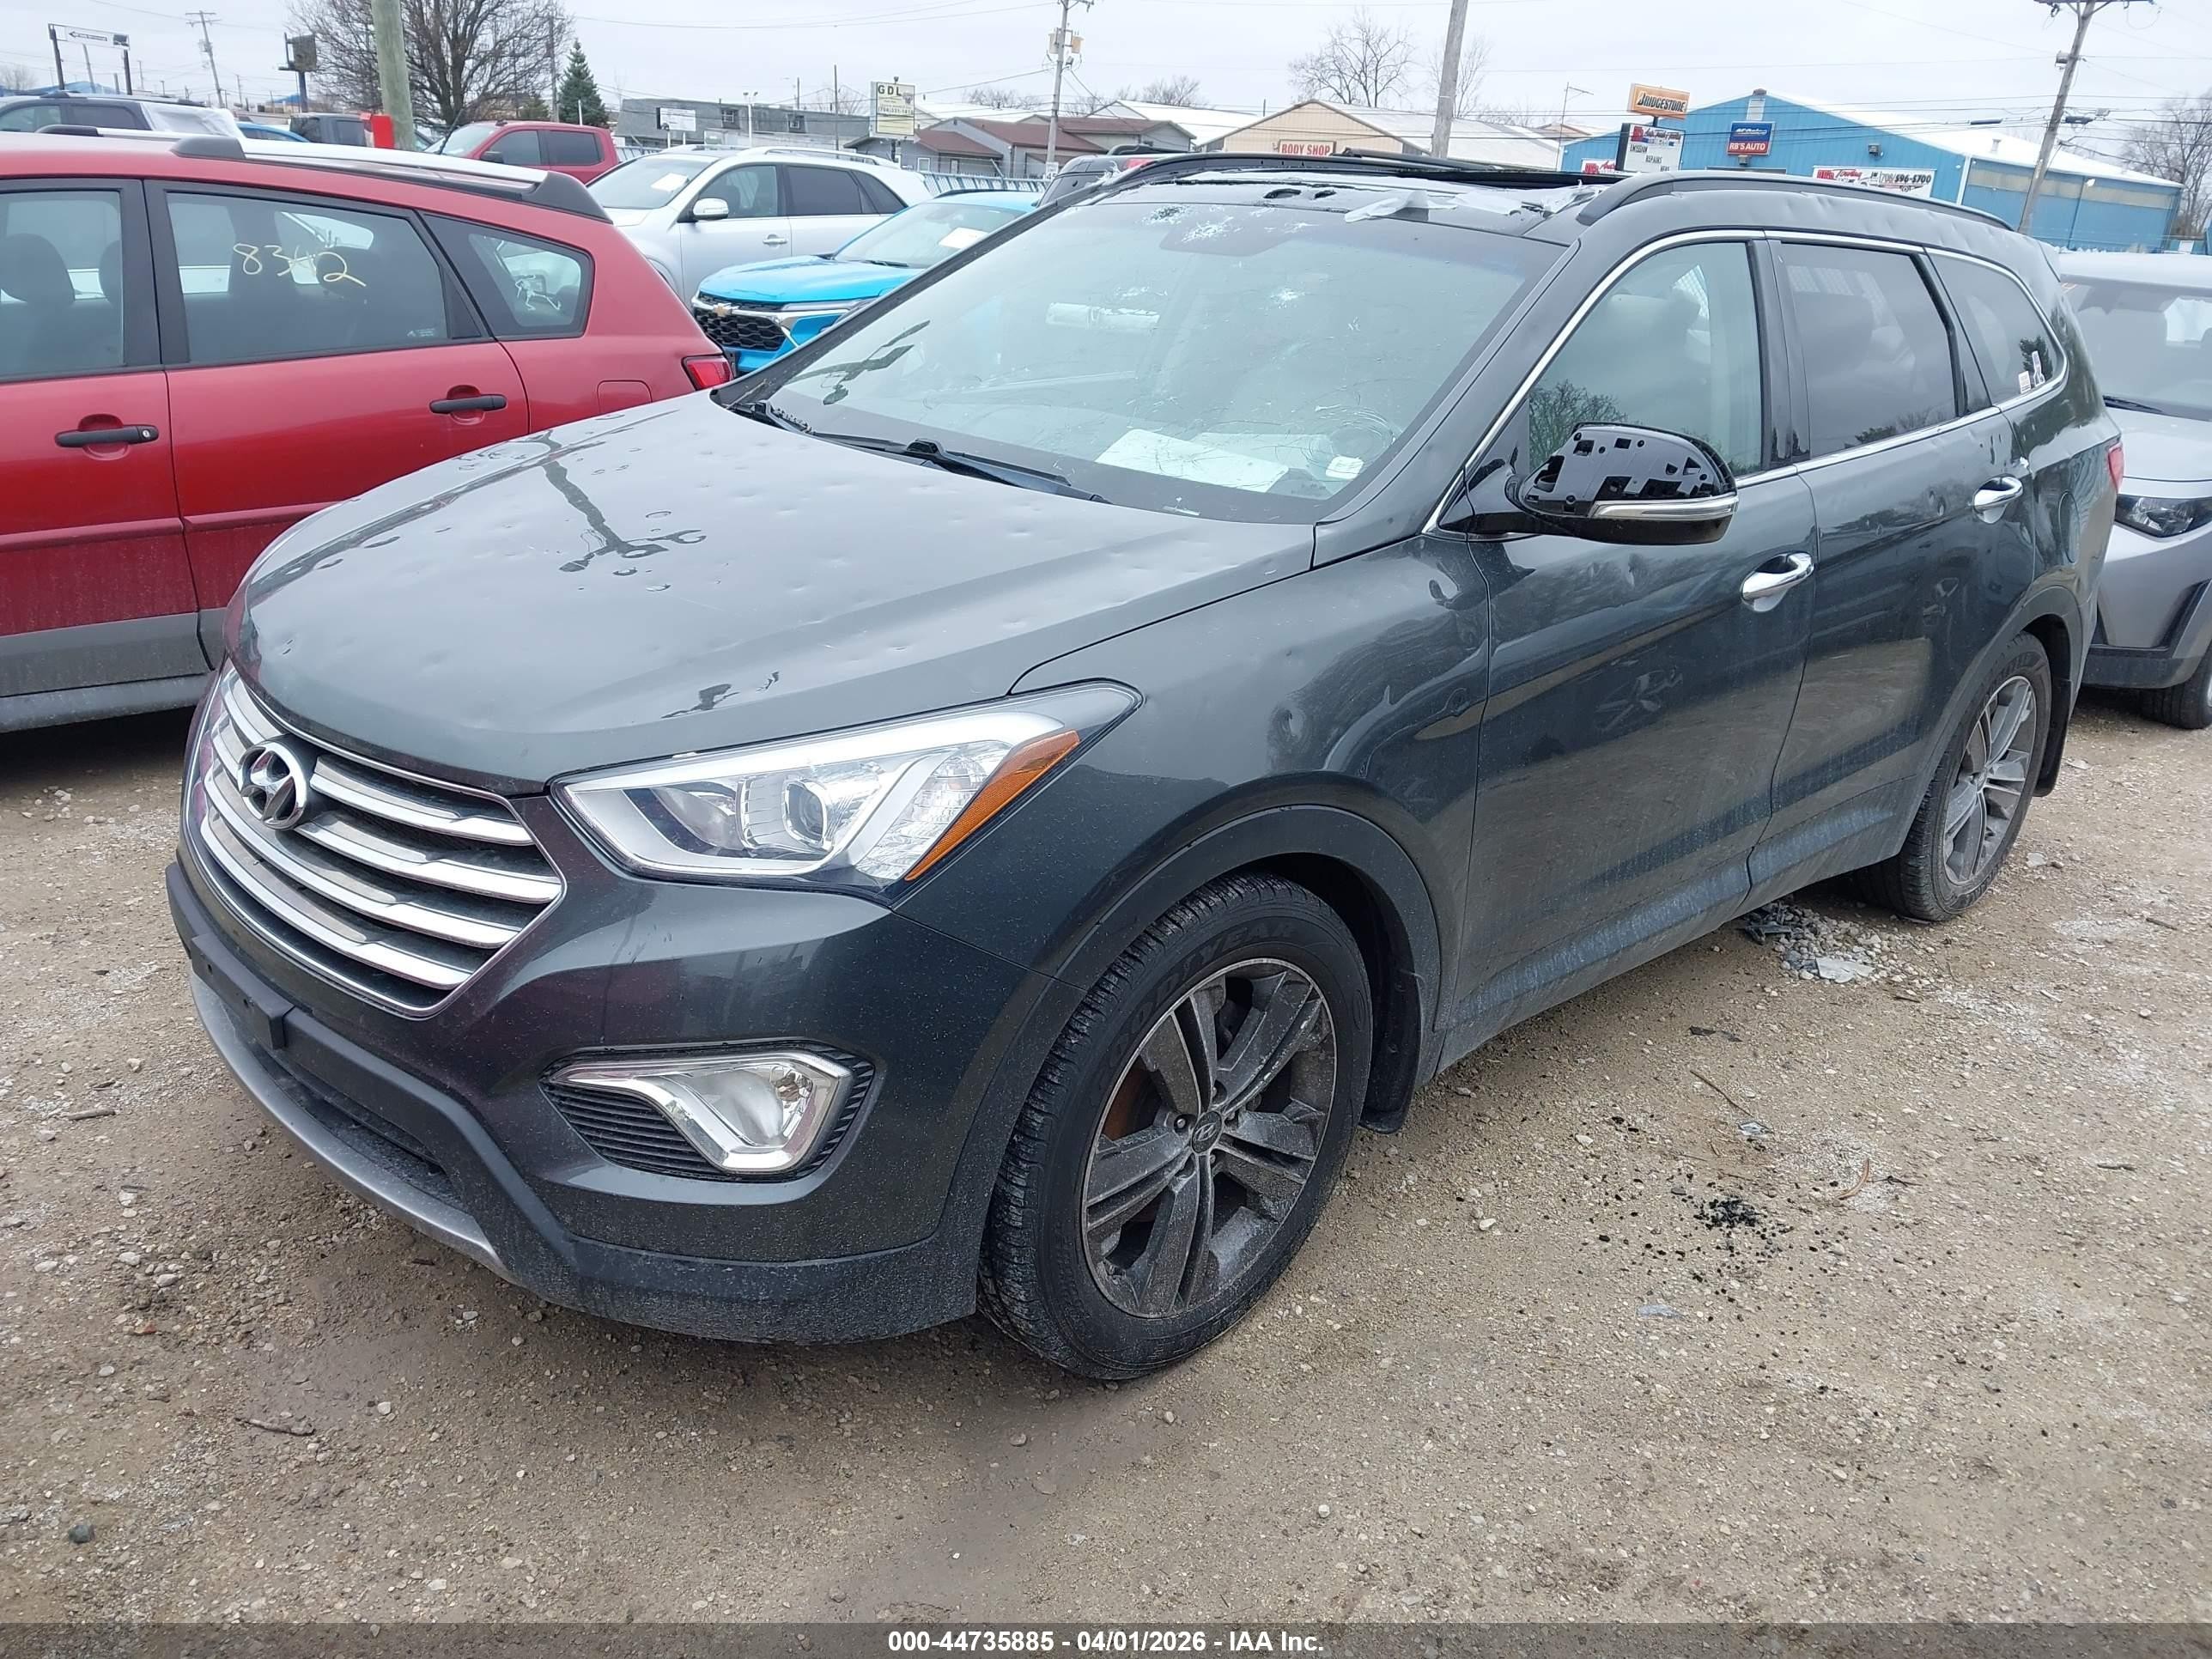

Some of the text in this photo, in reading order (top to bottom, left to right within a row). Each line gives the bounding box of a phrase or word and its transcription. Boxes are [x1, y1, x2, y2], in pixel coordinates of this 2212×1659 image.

[878, 85, 902, 96] GDL
[1637, 92, 1686, 112] BRIDGESTONE
[1281, 143, 1304, 155] BODY
[1307, 144, 1330, 156] SHOP
[1729, 142, 1766, 152] RB'S AUTO
[1645, 155, 1662, 164] REPAIRS
